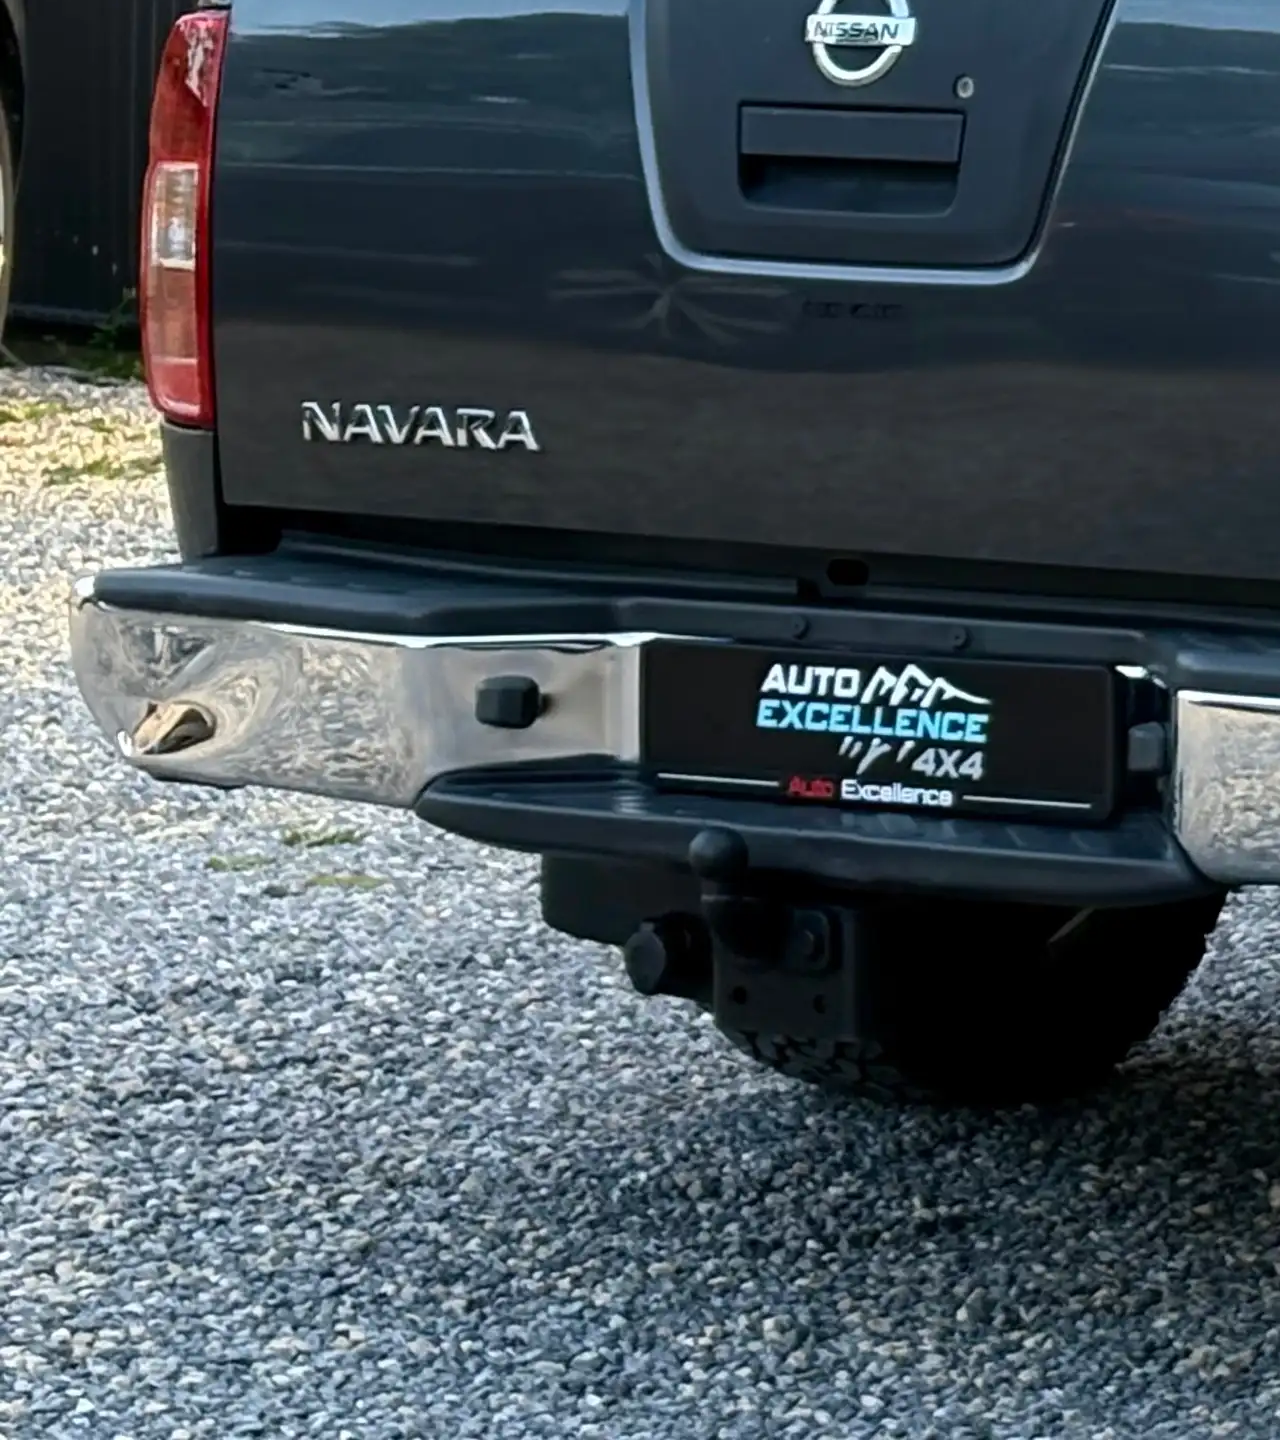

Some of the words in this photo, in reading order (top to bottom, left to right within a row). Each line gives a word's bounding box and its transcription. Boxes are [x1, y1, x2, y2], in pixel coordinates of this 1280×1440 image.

[813, 20, 900, 42] NISSAN
[300, 400, 542, 451] NAVARA
[760, 663, 862, 698] AUTO
[755, 698, 988, 743] EXCELLENCE
[910, 749, 984, 780] 4X4
[840, 778, 954, 807] Excellence
